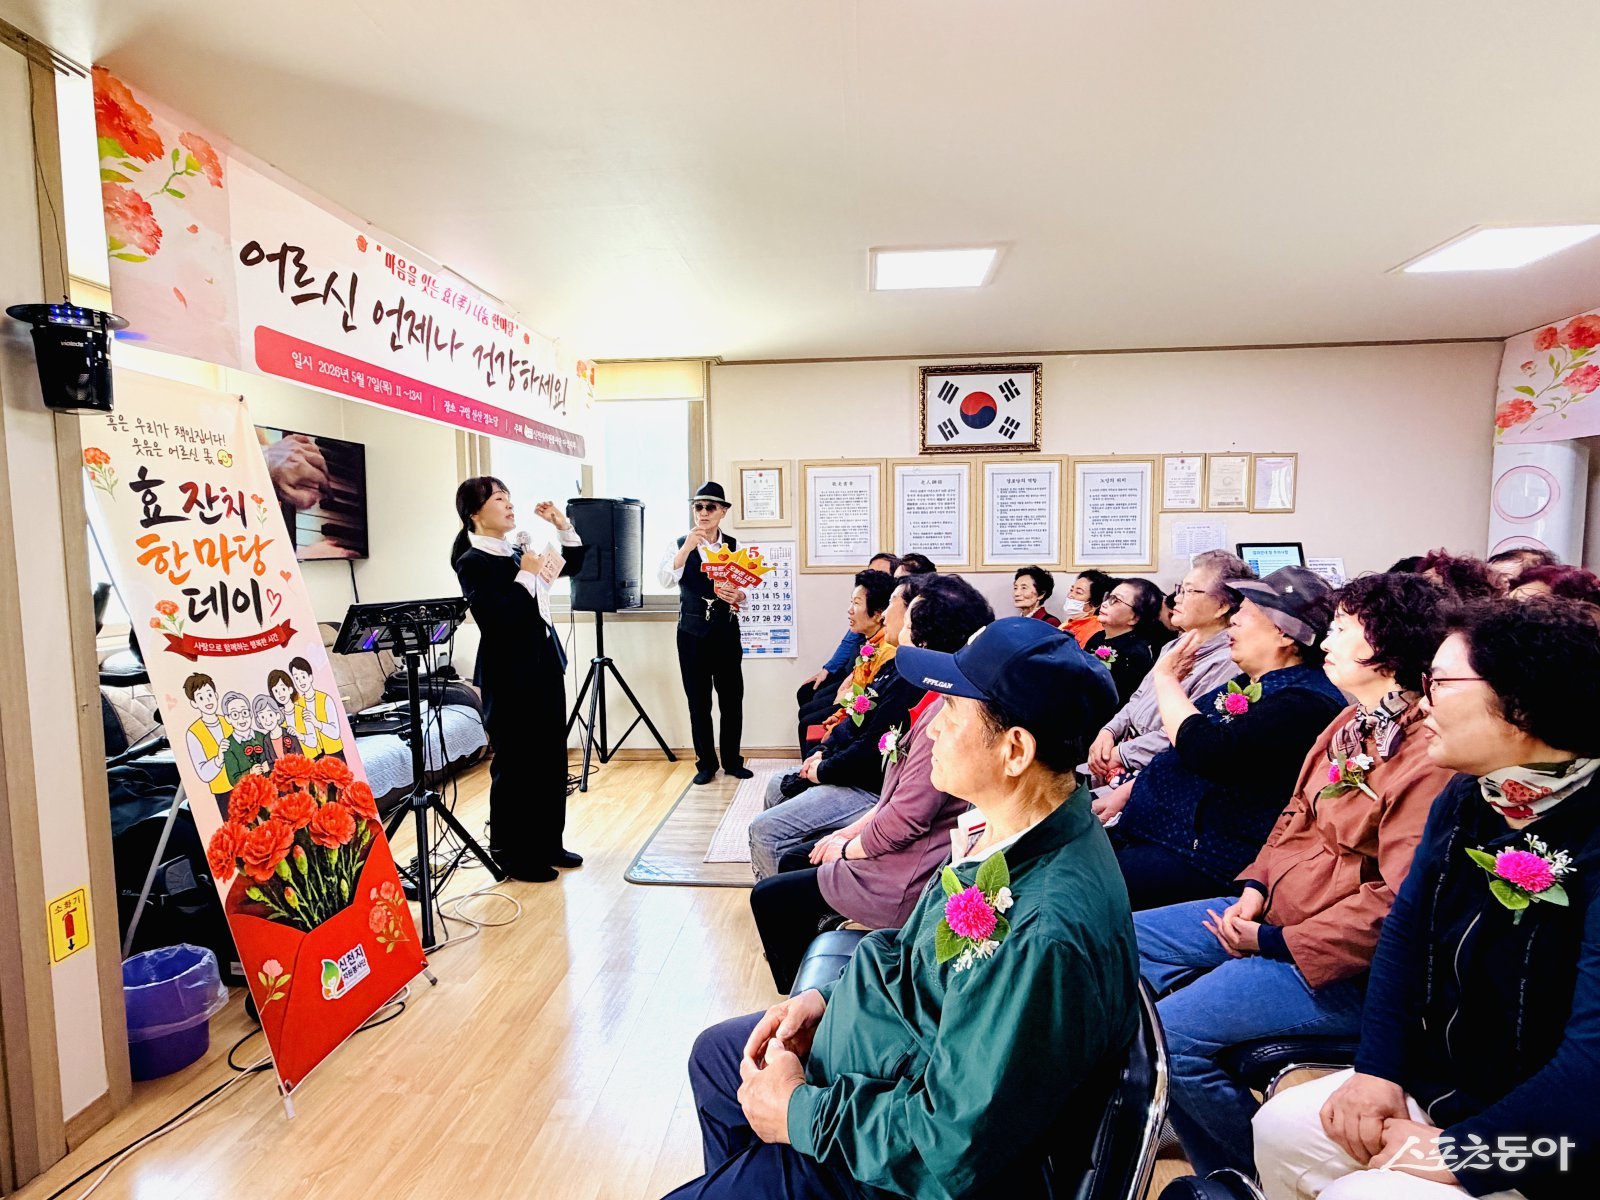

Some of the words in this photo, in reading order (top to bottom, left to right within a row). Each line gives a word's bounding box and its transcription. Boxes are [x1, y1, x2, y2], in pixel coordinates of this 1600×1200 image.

[421, 273, 439, 299] 잇는
[441, 287, 471, 315] 효(孝)
[239, 240, 358, 333] 어르신
[372, 296, 464, 363] 언제나
[472, 341, 568, 415] 건강하세요!
[291, 351, 313, 371] 일시
[318, 360, 349, 383] 2026년
[351, 371, 365, 388] 5월
[366, 375, 393, 396] 7일(목)
[444, 400, 457, 413] 장소
[459, 405, 471, 420] 구암
[106, 414, 129, 432] 흥은
[135, 417, 169, 438] 우리가
[174, 425, 226, 447] 책임집니다!
[132, 437, 163, 457] 웃음은
[168, 445, 200, 462] 어르신
[129, 465, 191, 529] 효
[178, 481, 248, 529] 잔치
[135, 533, 275, 586] 한마당
[749, 546, 760, 558] 5
[729, 565, 746, 578] 오늘은
[181, 578, 264, 632] 데이
[193, 641, 223, 652] 사랑으로
[223, 642, 250, 652] 함께하는
[249, 638, 268, 649] 행복한
[267, 632, 280, 643] 시간
[54, 895, 81, 914] 소화기
[339, 946, 364, 972] 신천지
[343, 958, 367, 979] 자원봉사단
